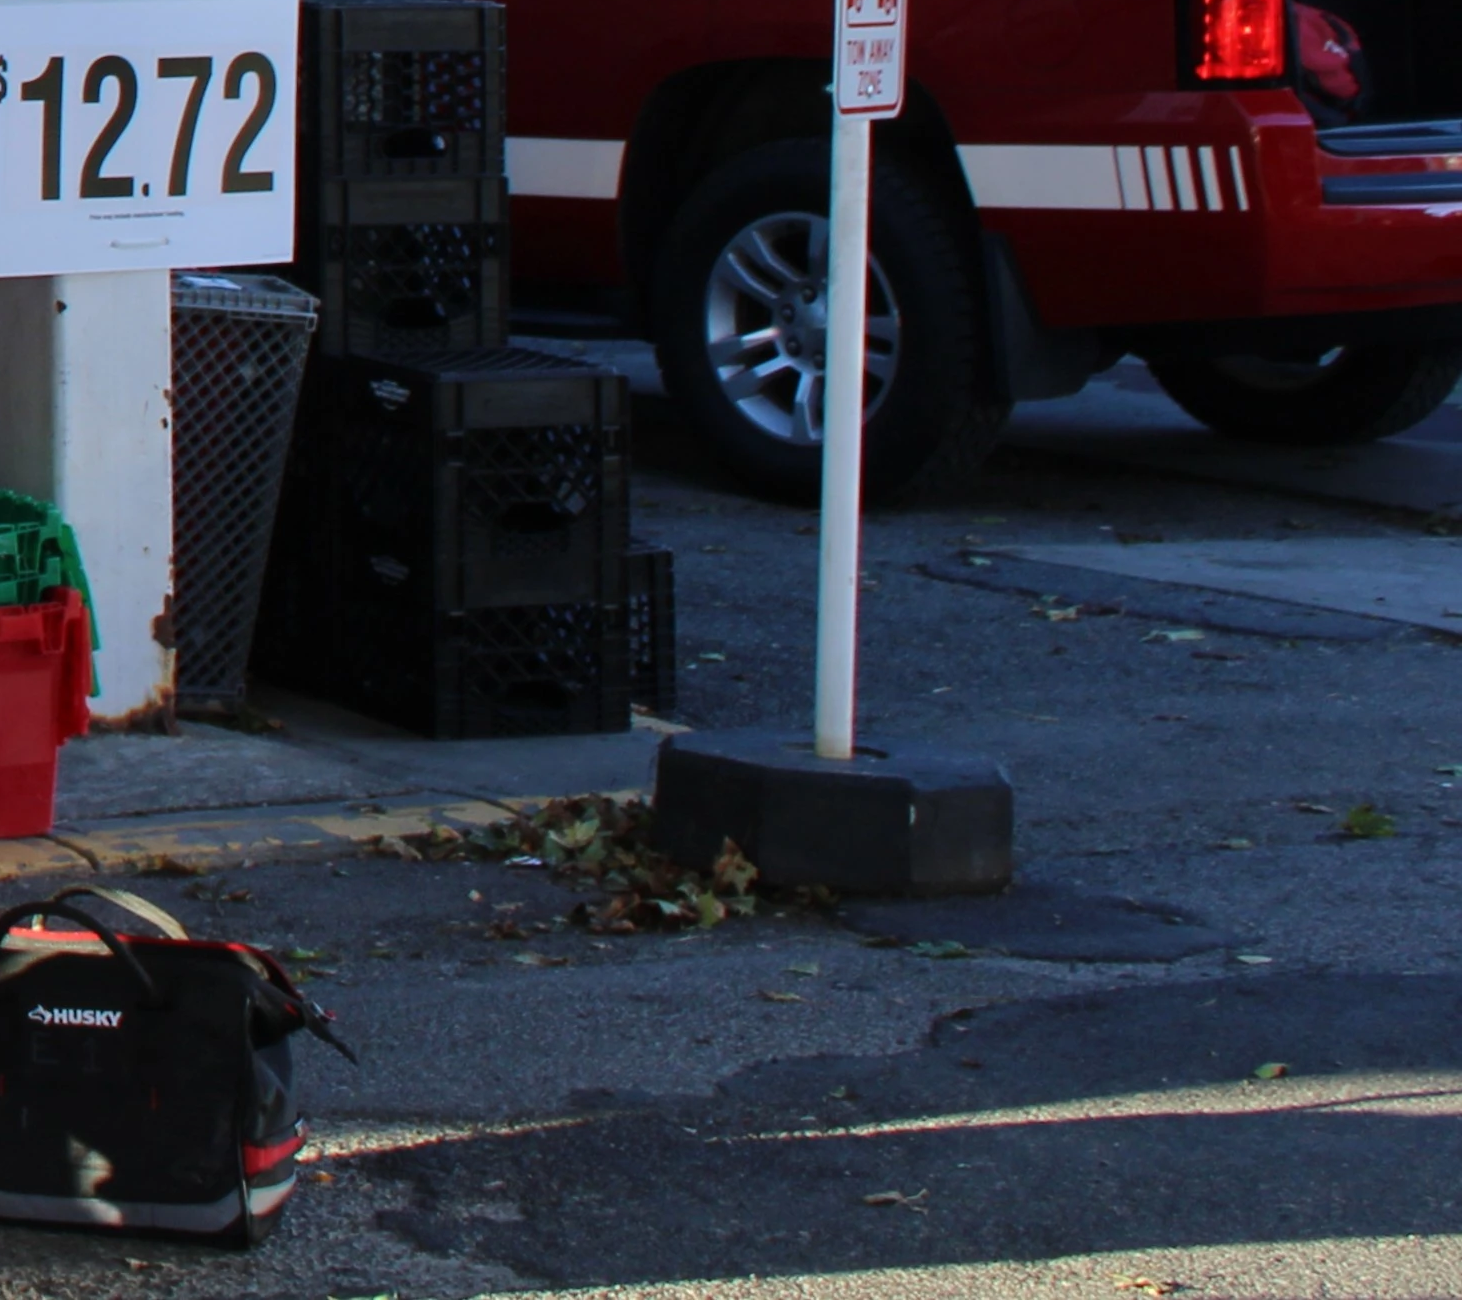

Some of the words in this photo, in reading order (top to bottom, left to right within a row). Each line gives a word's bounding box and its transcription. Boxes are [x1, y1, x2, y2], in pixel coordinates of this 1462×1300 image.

[846, 39, 866, 66] TOW
[869, 37, 896, 65] AWAY
[857, 68, 883, 98] ZONE
[52, 1007, 123, 1027] HUSKY
